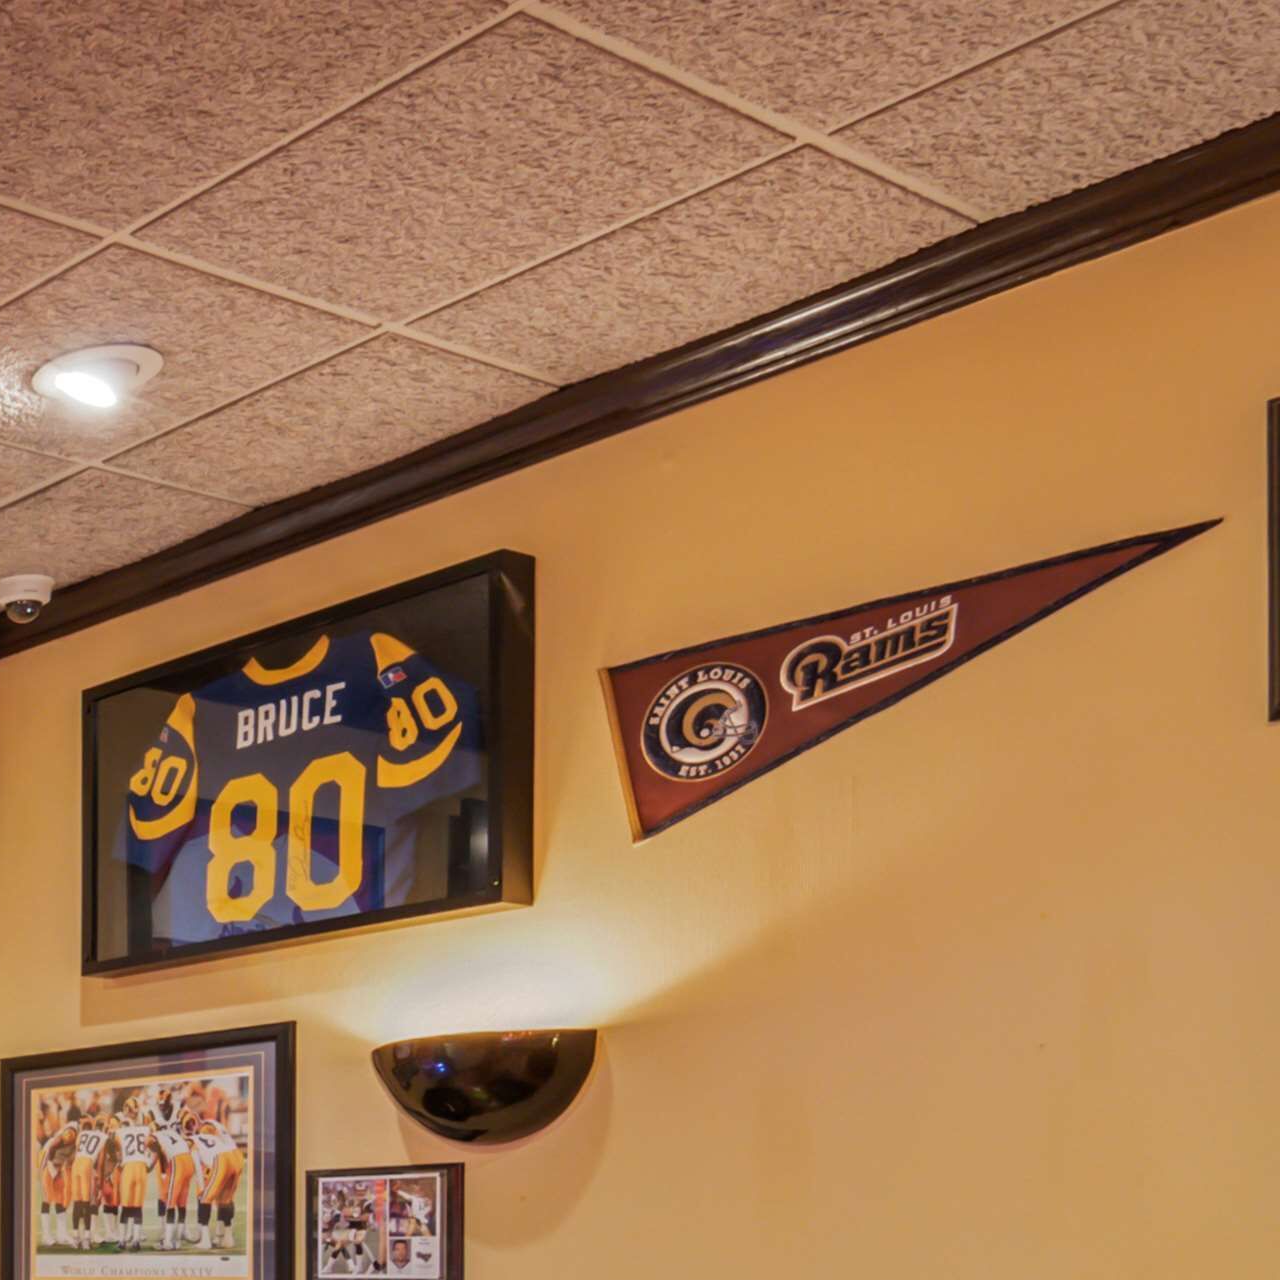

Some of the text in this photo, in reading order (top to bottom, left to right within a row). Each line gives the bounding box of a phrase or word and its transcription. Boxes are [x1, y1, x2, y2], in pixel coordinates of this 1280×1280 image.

[849, 594, 953, 645] ST. LOUIS
[783, 606, 956, 706] Rams
[236, 681, 346, 750] BRUCE
[385, 676, 459, 752] 80
[648, 667, 752, 725] SAINT LOUIS
[129, 746, 188, 806] 80
[678, 765, 712, 777] EST.
[206, 751, 367, 924] 80
